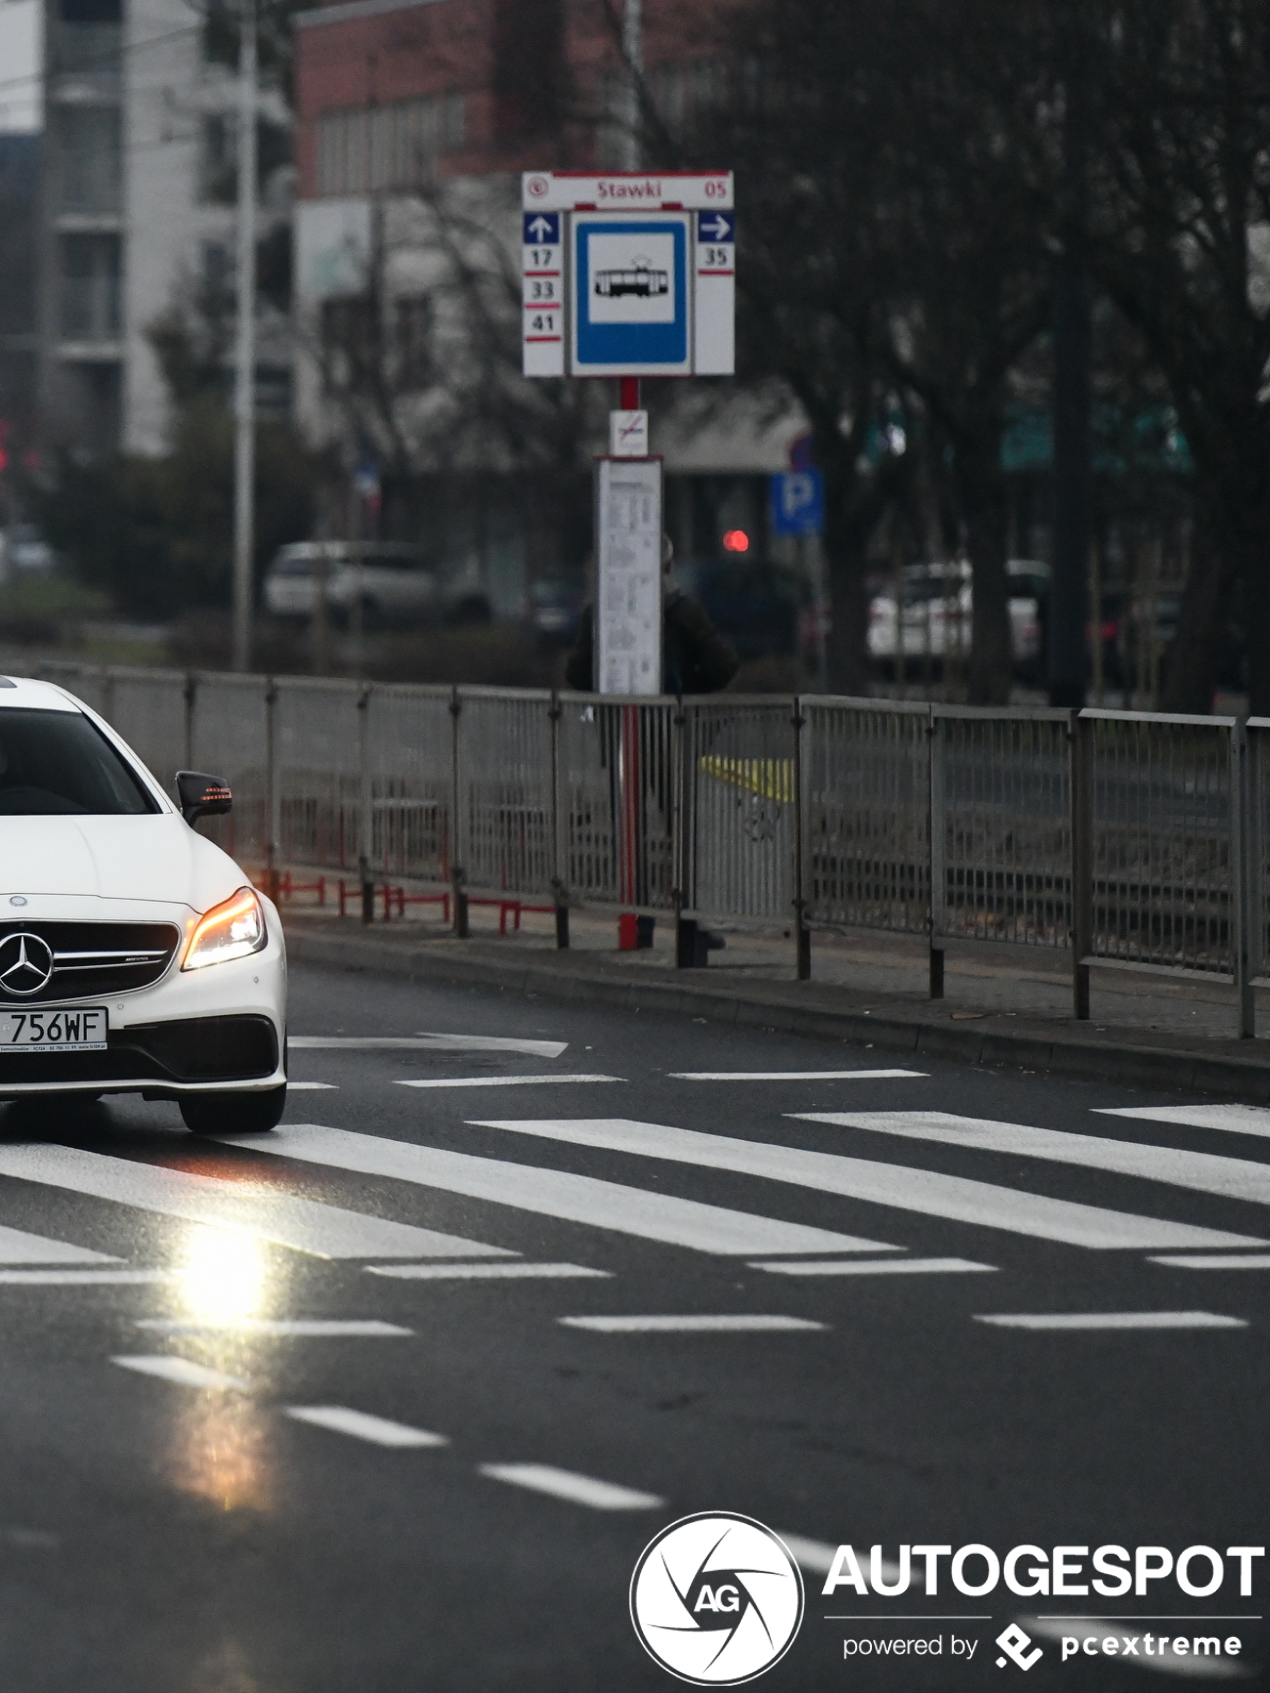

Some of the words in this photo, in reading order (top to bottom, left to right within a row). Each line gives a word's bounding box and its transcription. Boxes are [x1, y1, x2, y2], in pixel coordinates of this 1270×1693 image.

[597, 181, 661, 199] Stawki
[704, 182, 727, 198] 05
[532, 250, 552, 266] 17
[705, 249, 728, 265] 35
[532, 282, 554, 298] 33
[532, 315, 554, 331] 41
[782, 473, 814, 518] P
[11, 1013, 99, 1043] 756WF
